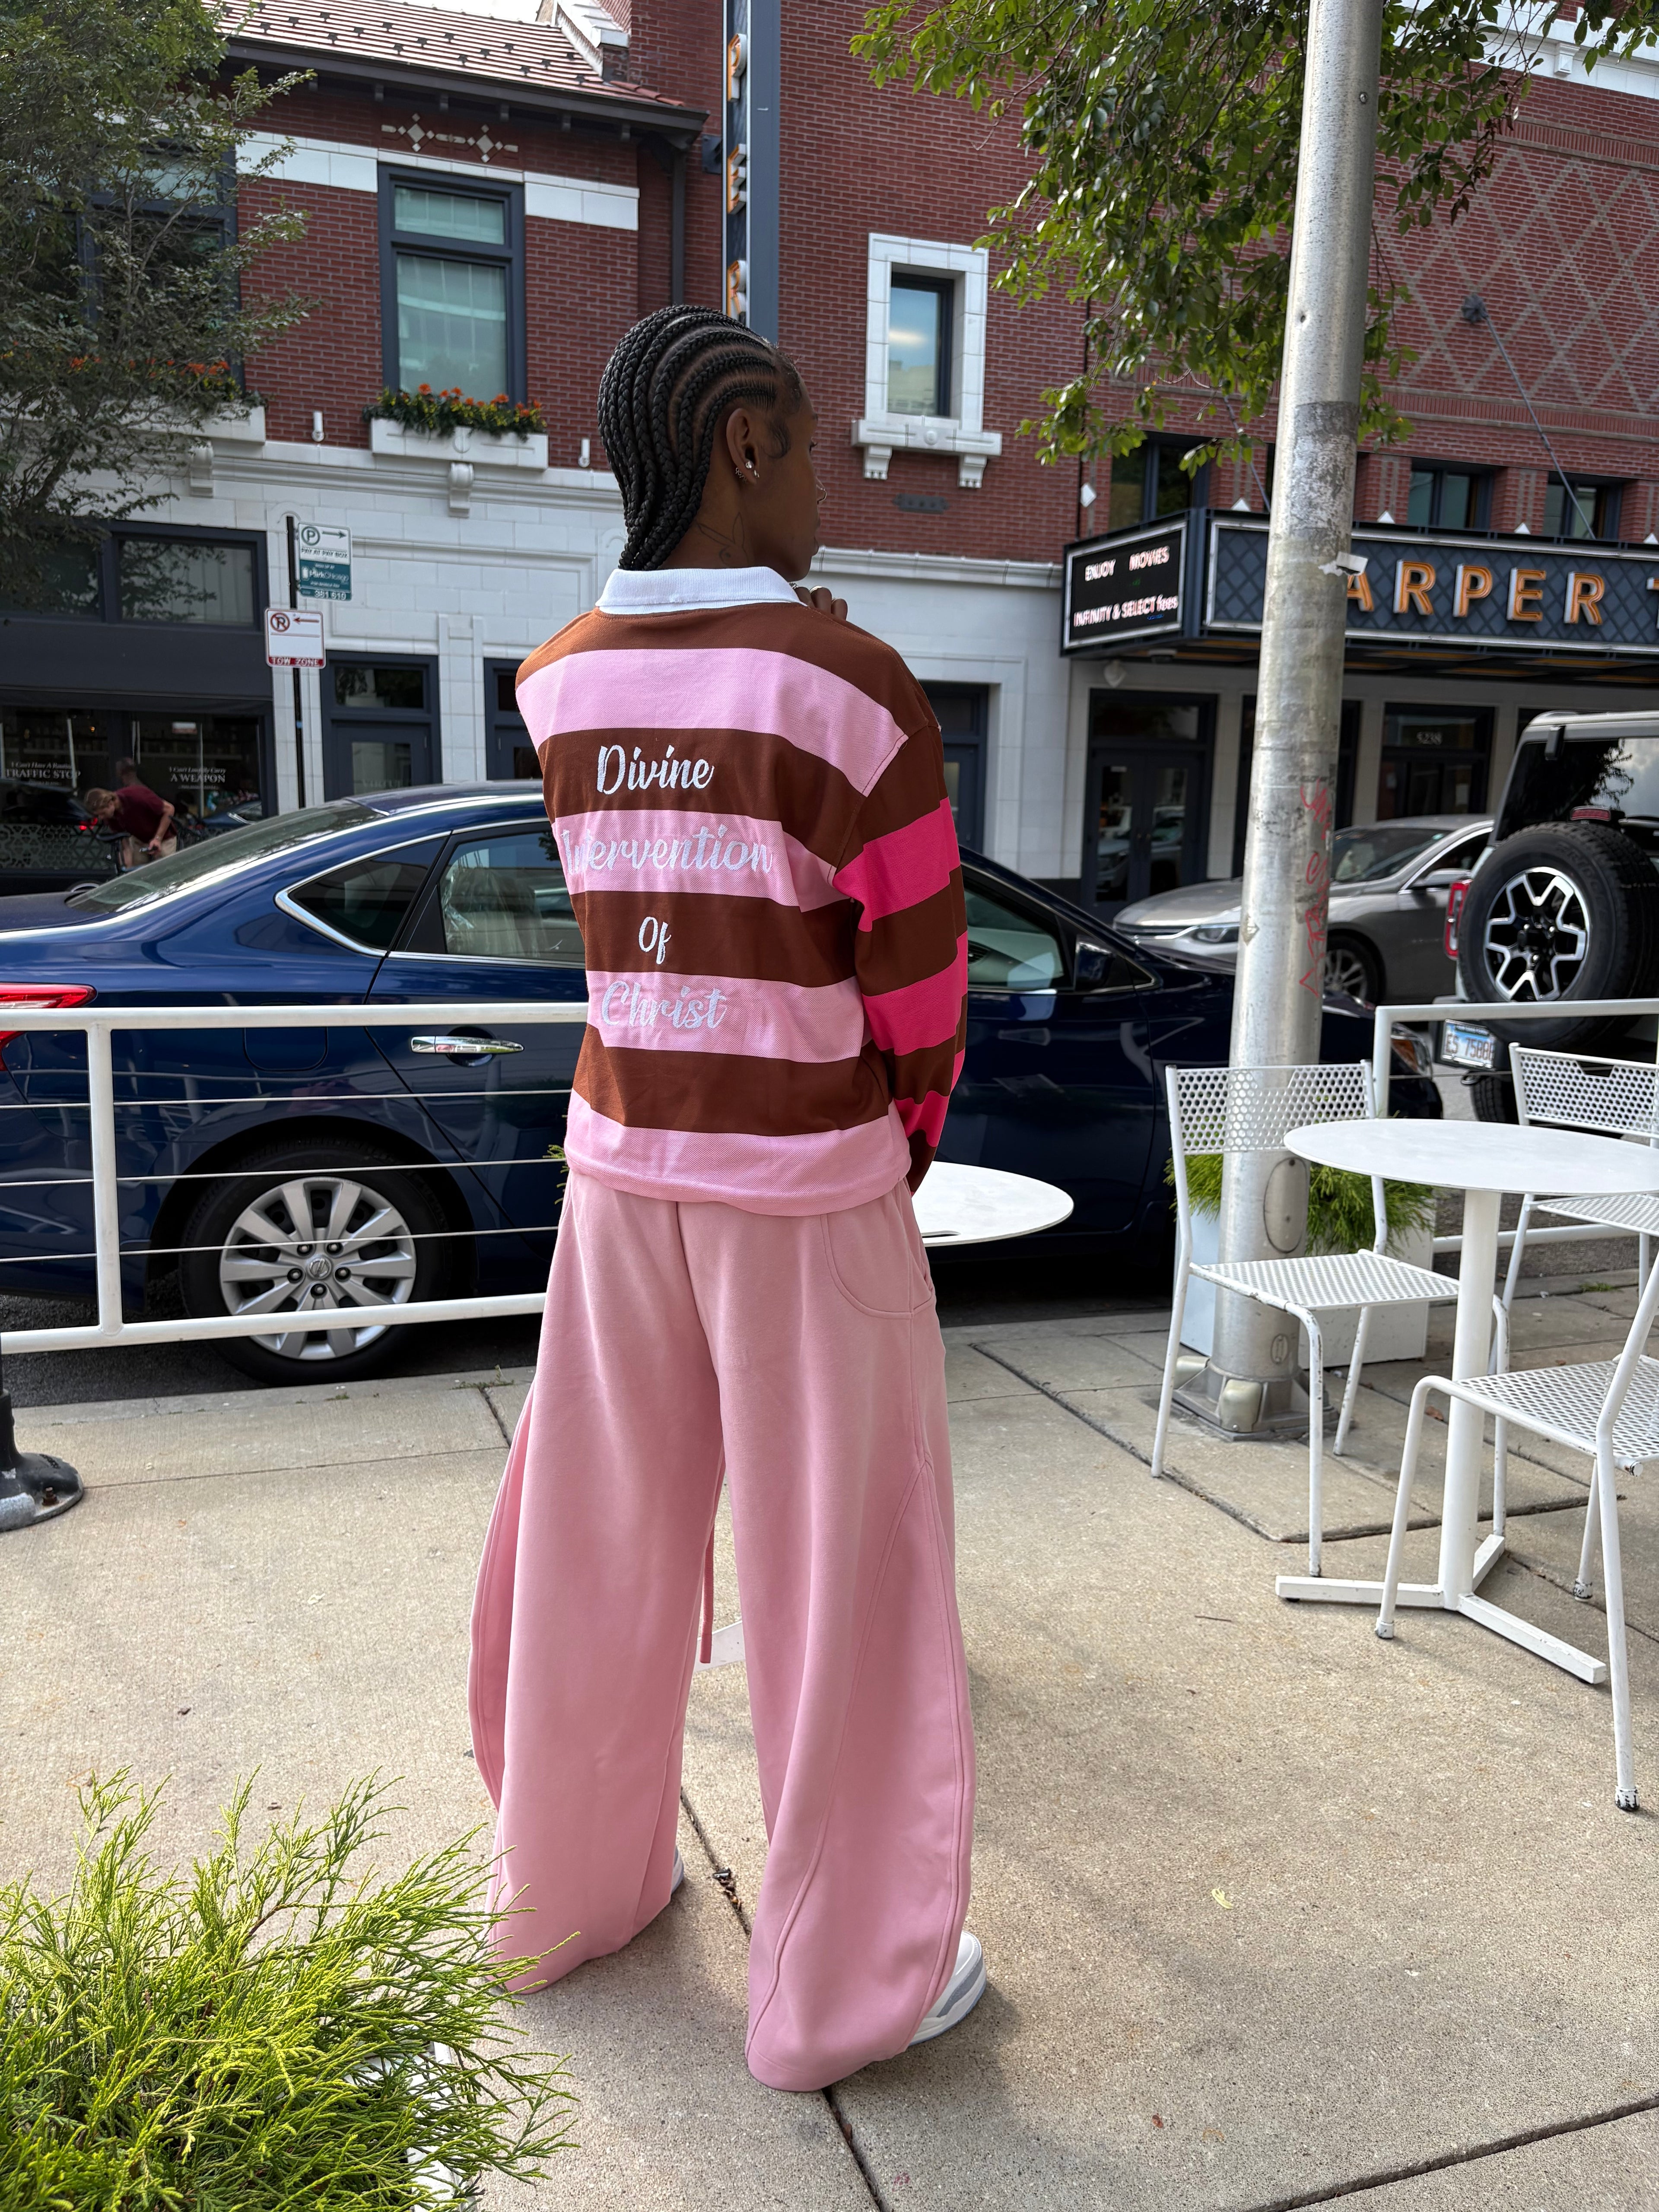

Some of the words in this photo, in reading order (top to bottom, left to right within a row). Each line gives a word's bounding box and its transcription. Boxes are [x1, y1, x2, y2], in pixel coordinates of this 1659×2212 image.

[1085, 558, 1116, 582] ENJOY
[1128, 545, 1170, 571] MOVIES
[1073, 605, 1112, 627] INFINITY
[1112, 603, 1121, 620] &
[1122, 595, 1157, 619] SELECT
[1347, 559, 1605, 626] ARPER
[271, 657, 291, 666] TOW
[296, 658, 319, 667] ZONE
[6, 768, 51, 779] TRAFFIC
[170, 773, 178, 782] A
[179, 773, 226, 783] WEAPON
[596, 744, 715, 795] Divine
[638, 916, 672, 965] Of
[600, 980, 729, 1029] Christ
